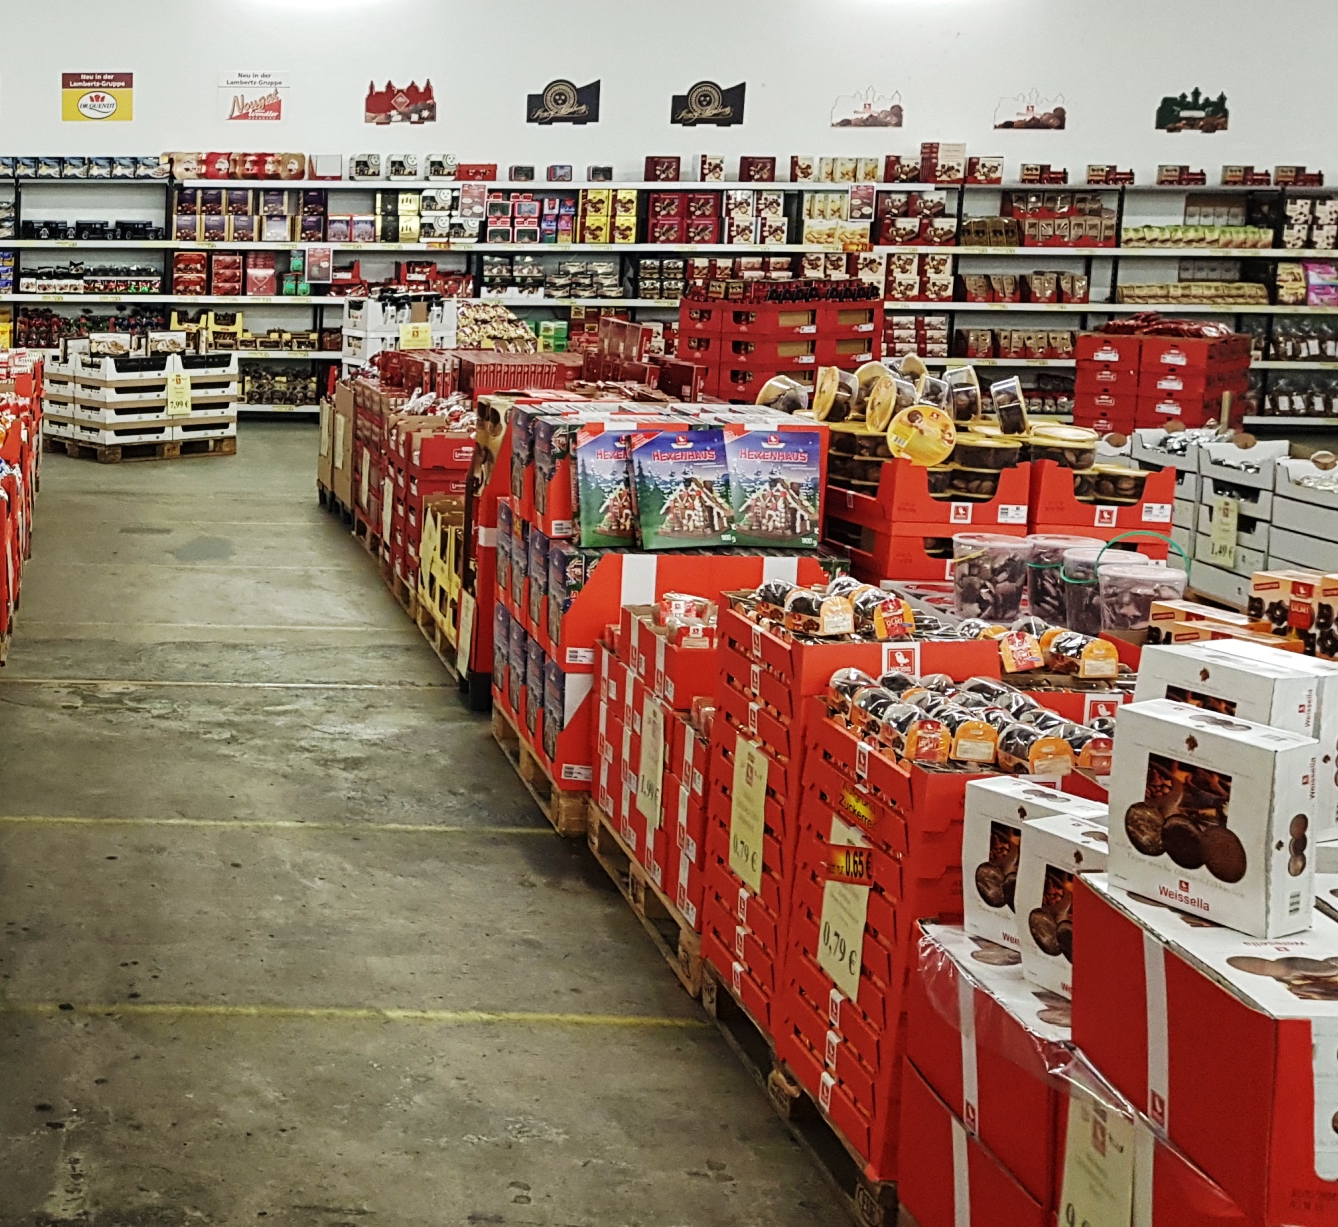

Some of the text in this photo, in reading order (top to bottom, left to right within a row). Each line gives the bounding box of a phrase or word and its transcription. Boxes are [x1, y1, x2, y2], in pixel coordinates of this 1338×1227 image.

[170, 401, 184, 409] 7,99
[651, 450, 716, 462] HEXENHAUS
[739, 447, 809, 462] HEXENHAUS
[1158, 885, 1210, 912] Weissella
[823, 921, 846, 962] 0,79
[849, 949, 858, 976] €
